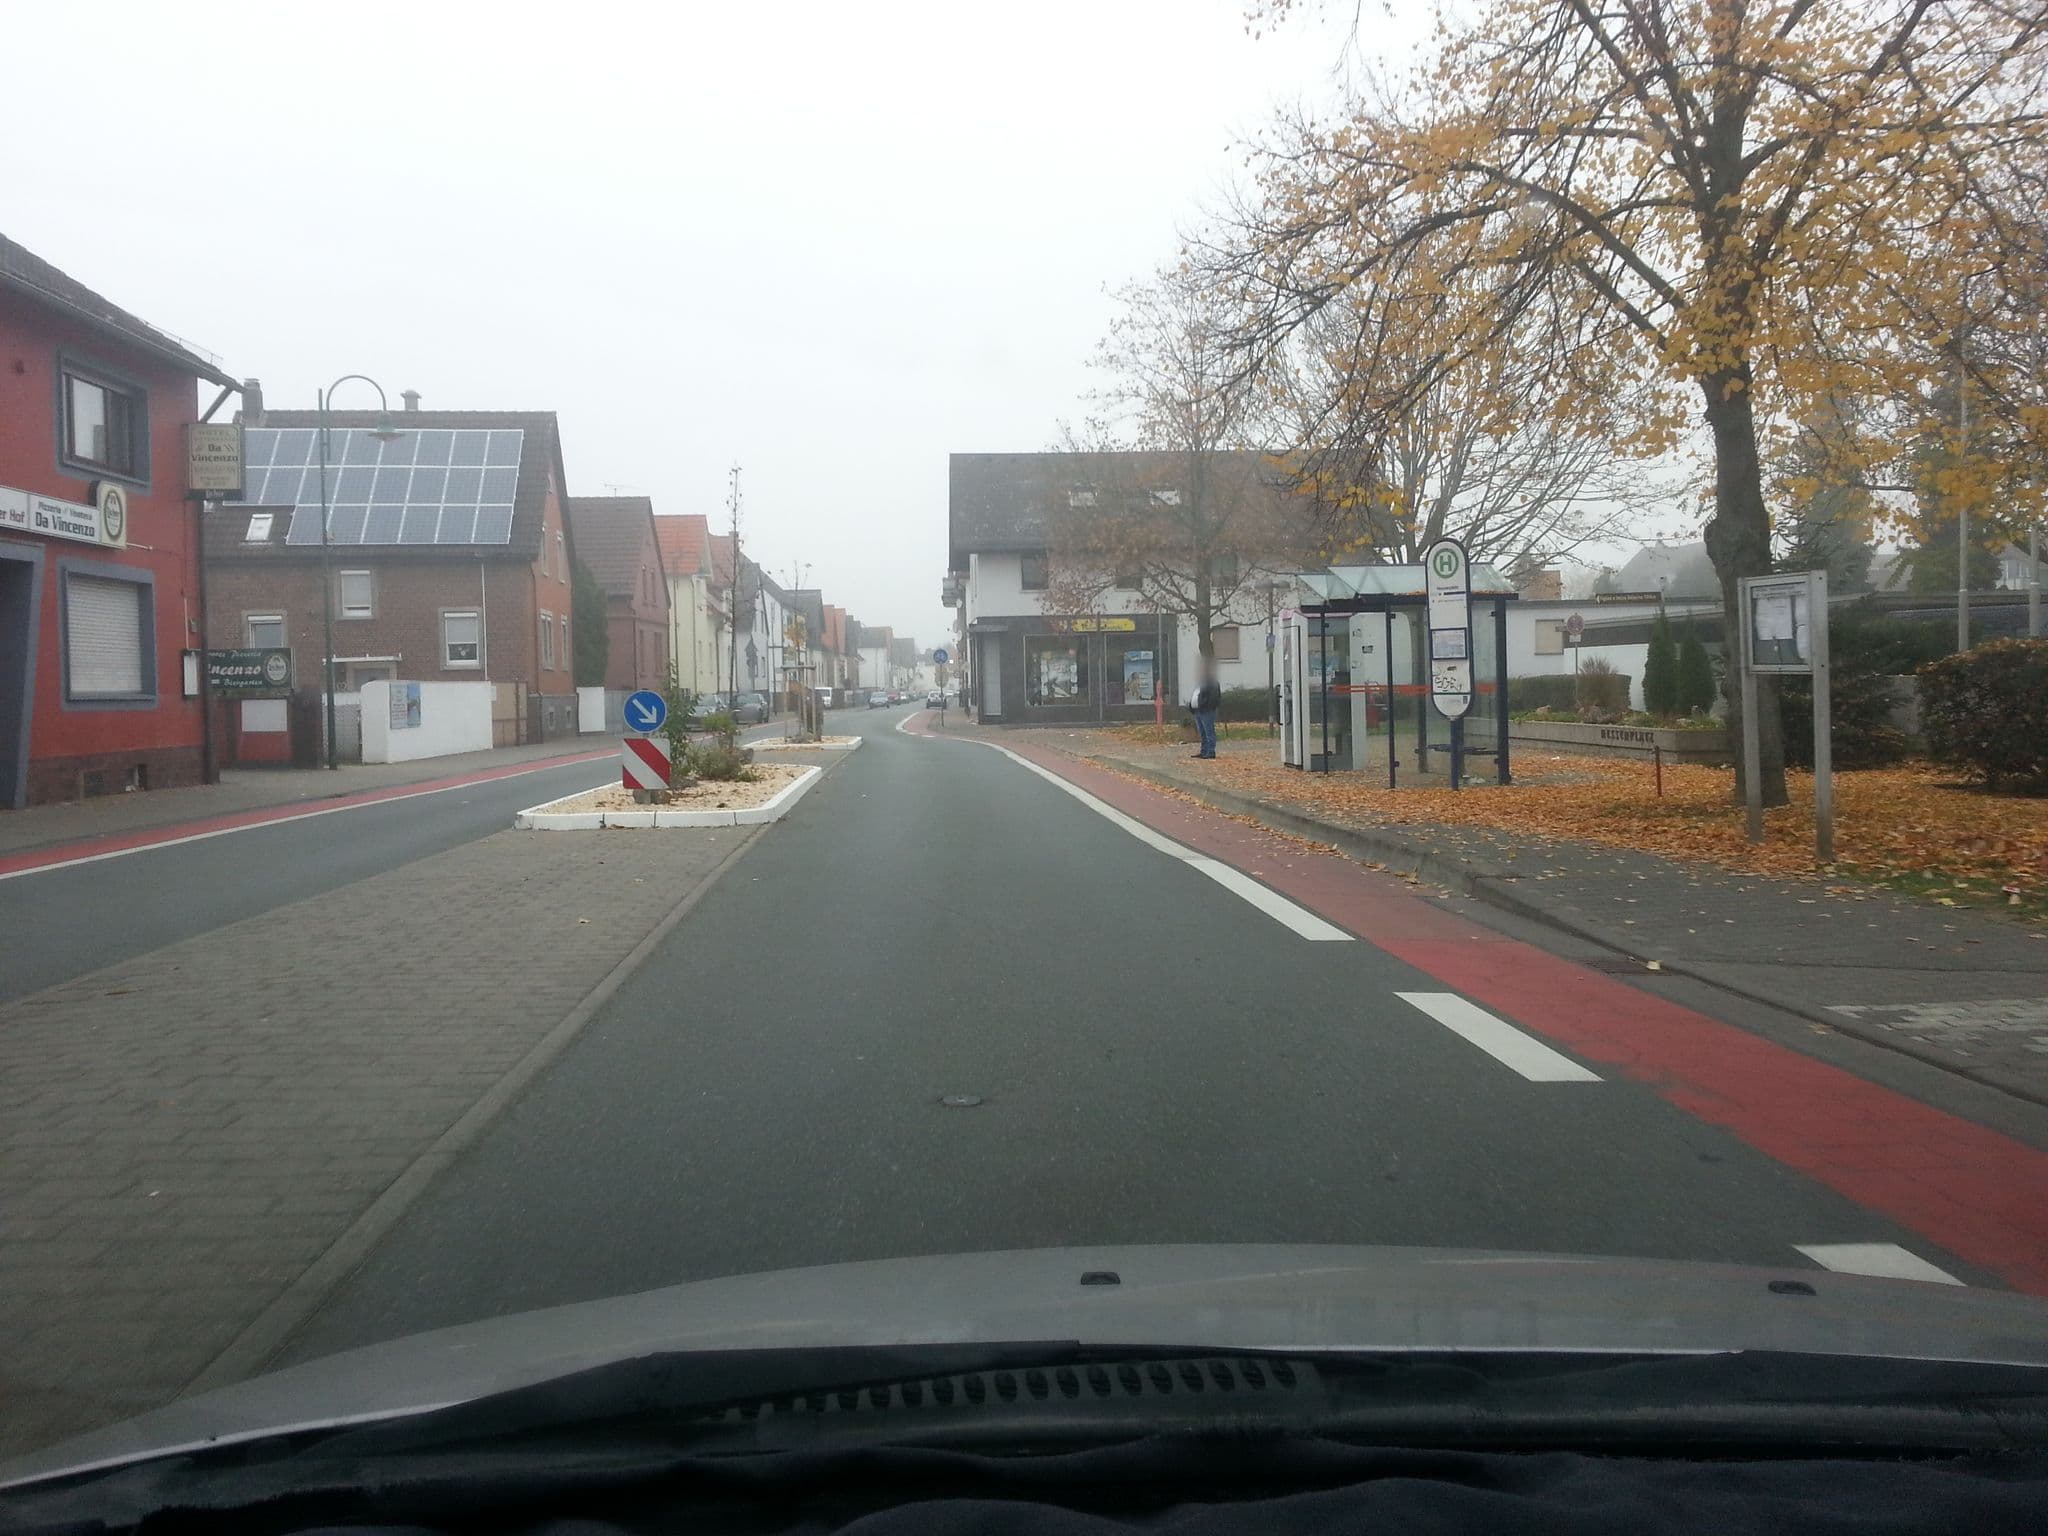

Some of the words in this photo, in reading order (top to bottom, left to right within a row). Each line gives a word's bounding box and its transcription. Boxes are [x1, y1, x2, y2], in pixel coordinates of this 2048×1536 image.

[208, 443, 222, 452] Da
[191, 454, 239, 462] Vincenzo
[9, 509, 25, 523] Hof
[35, 512, 49, 529] Da
[51, 515, 95, 537] Vincenzo
[1439, 554, 1452, 572] H
[208, 663, 261, 676] incenzo
